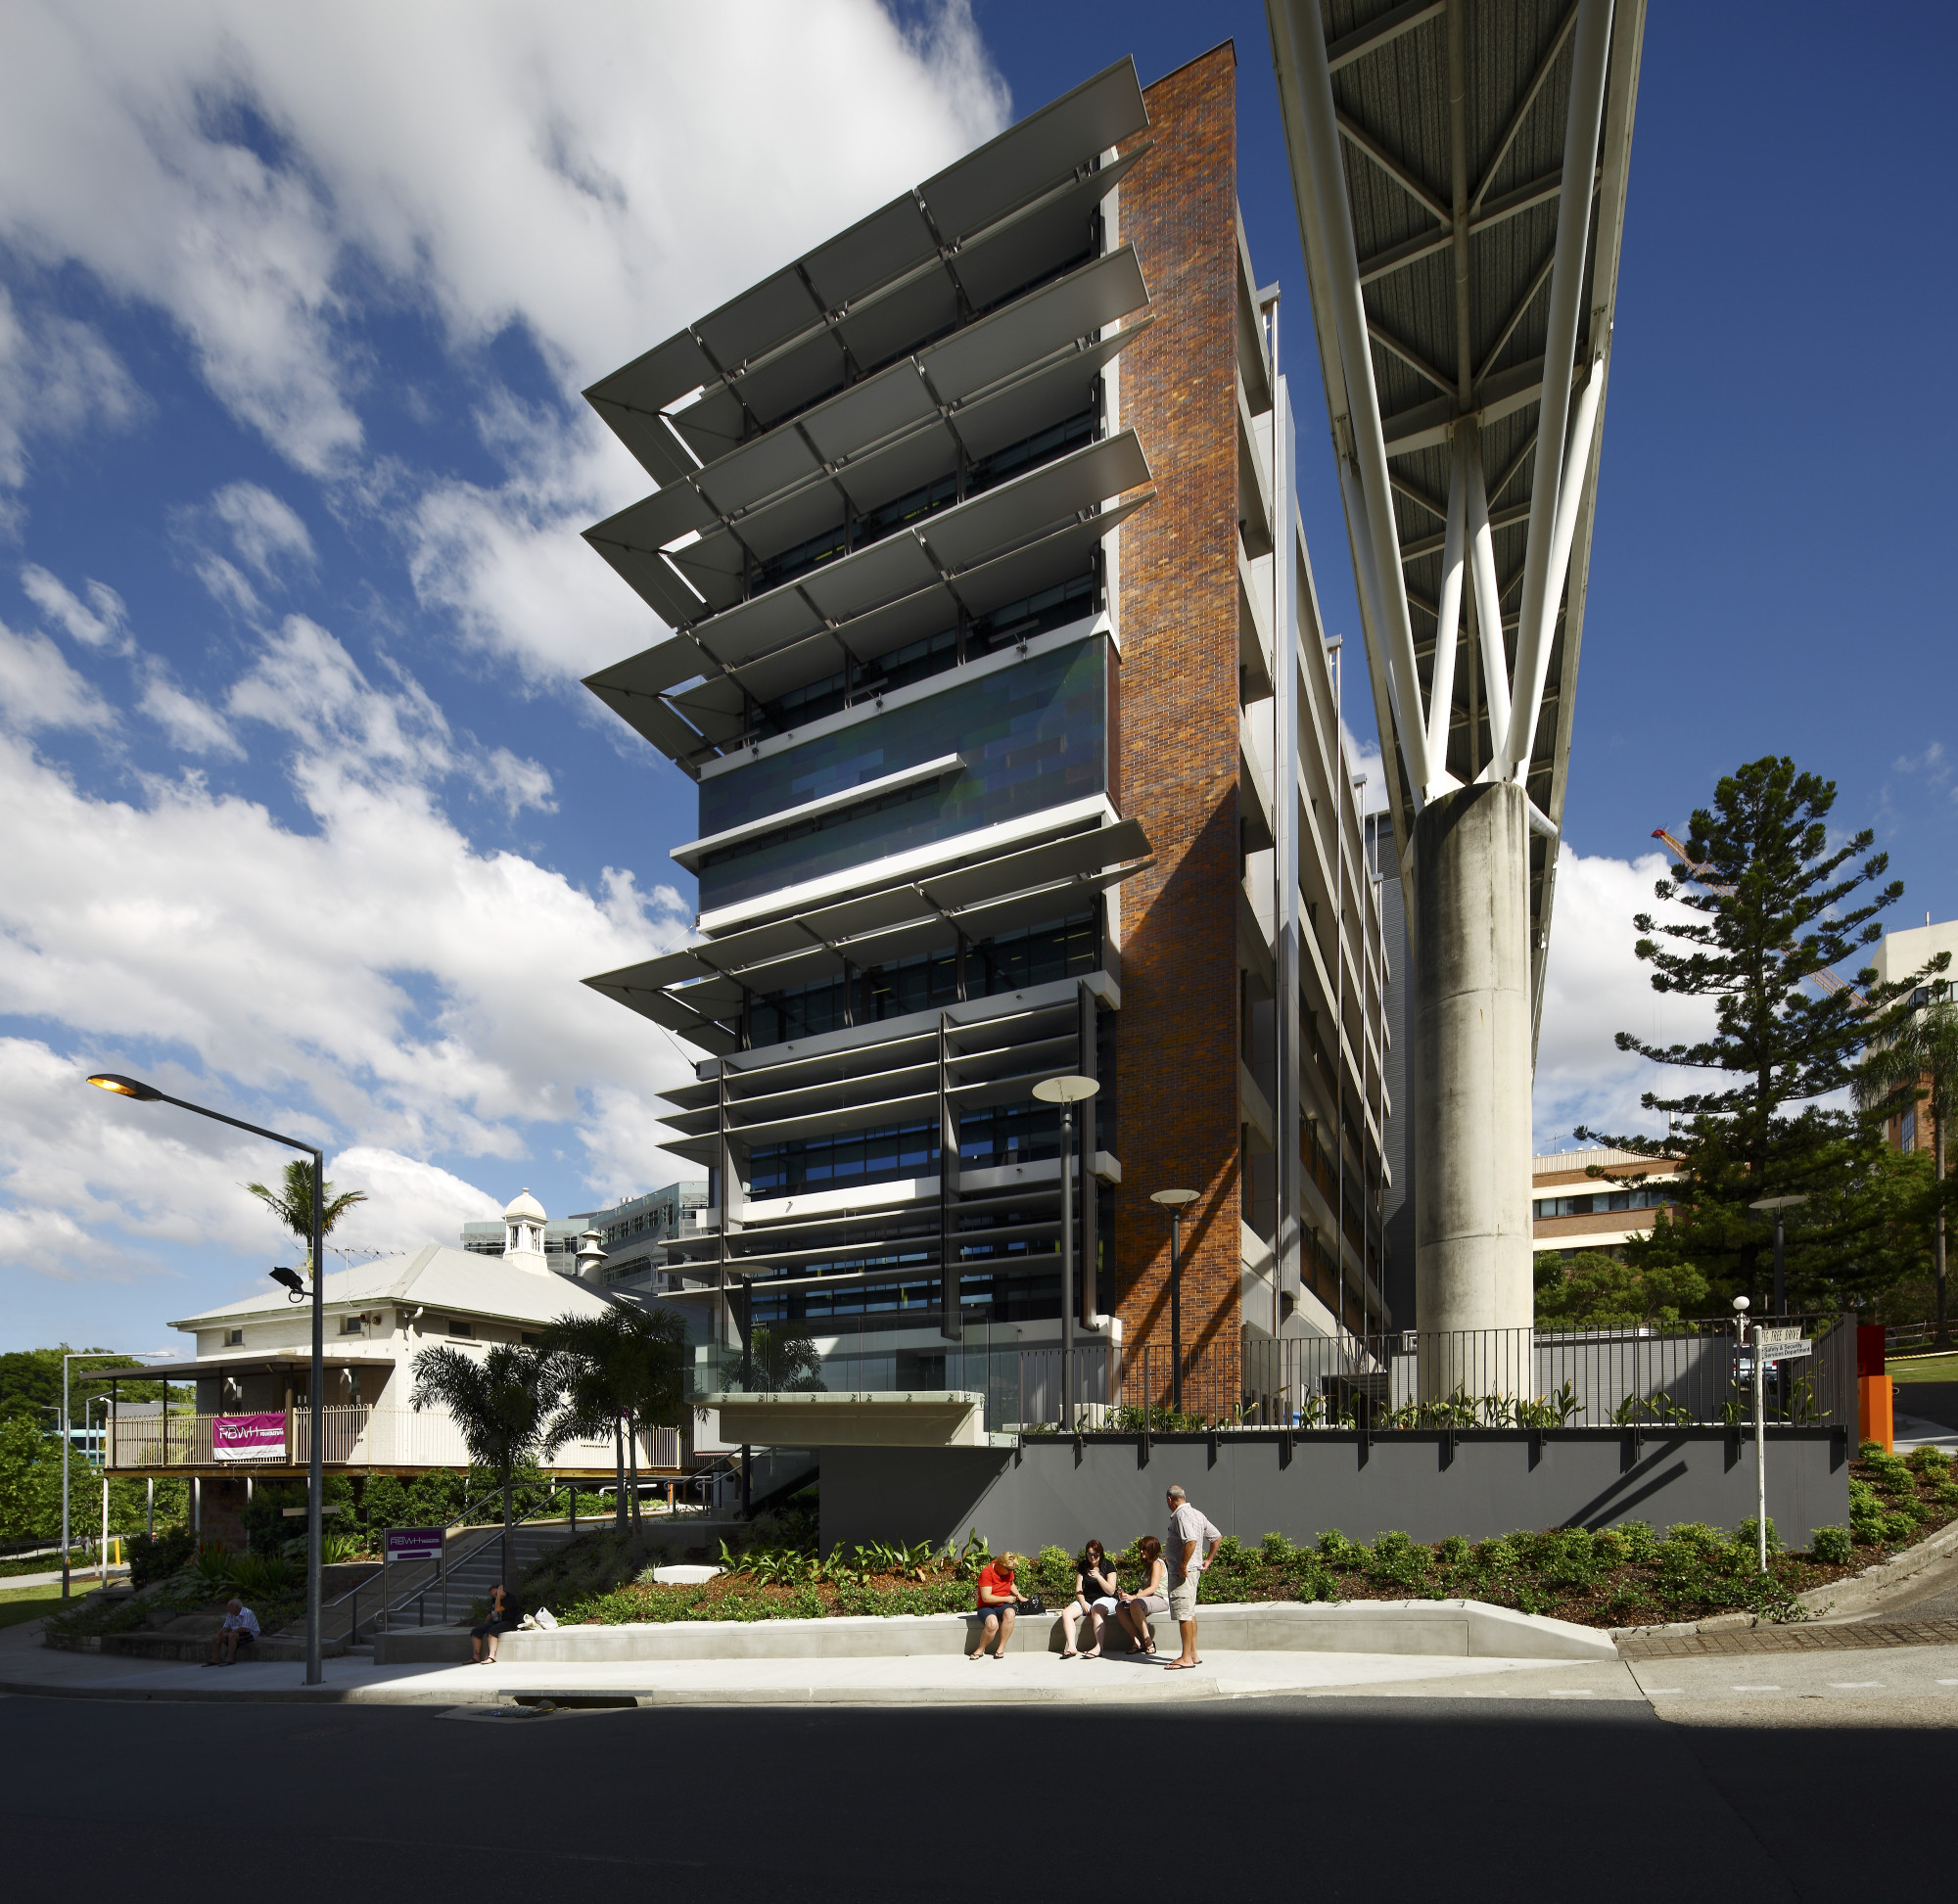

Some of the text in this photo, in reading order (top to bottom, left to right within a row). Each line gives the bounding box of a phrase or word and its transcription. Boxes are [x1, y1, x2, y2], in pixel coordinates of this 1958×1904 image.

[1771, 1330, 1783, 1341] TREE
[1785, 1329, 1799, 1340] DRIVE
[1785, 1347, 1810, 1356] Department
[219, 1425, 259, 1439] RBWH
[390, 1536, 422, 1546] RBWH
